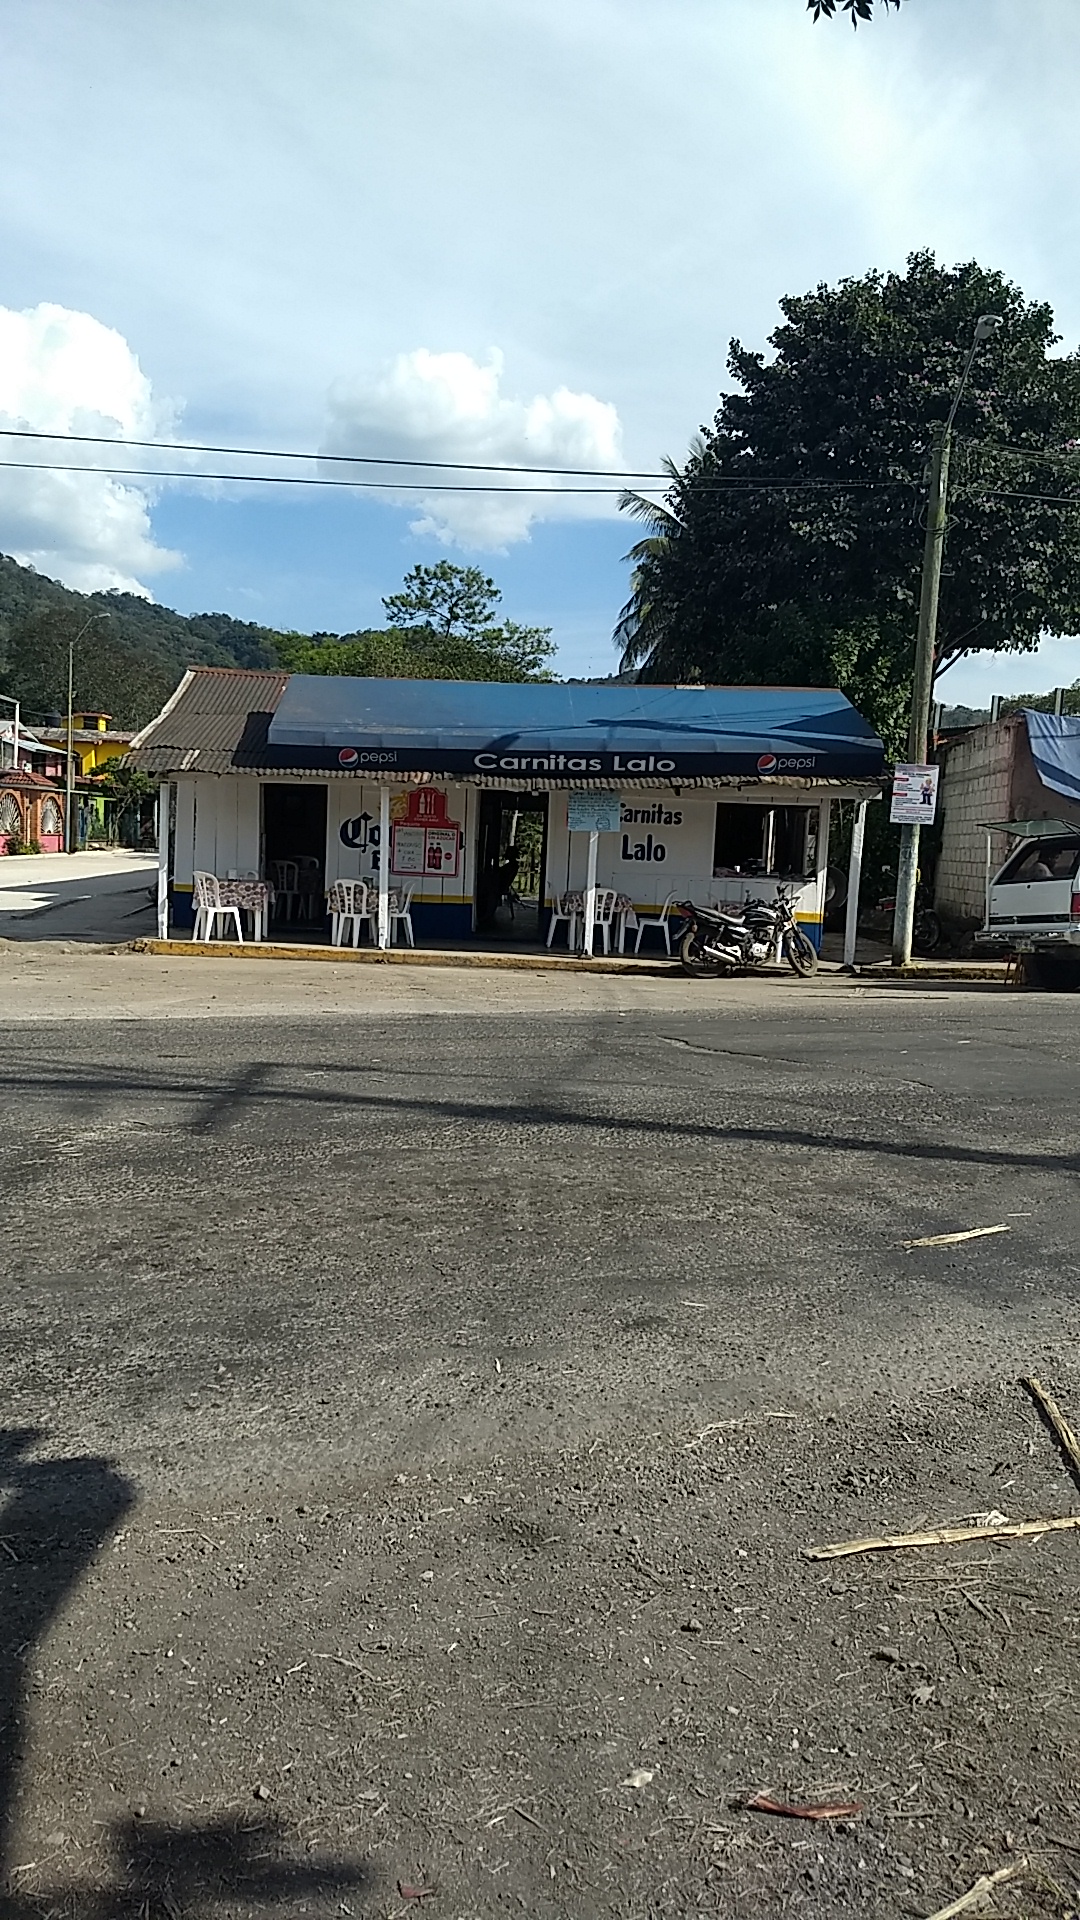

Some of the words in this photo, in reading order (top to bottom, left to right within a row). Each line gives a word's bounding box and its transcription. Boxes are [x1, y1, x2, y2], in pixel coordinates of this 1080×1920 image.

[360, 751, 398, 764] pepsi
[474, 753, 602, 771] Carnitas
[613, 756, 676, 772] Lalo
[777, 756, 816, 770] pepsi
[622, 834, 666, 861] Lalo
